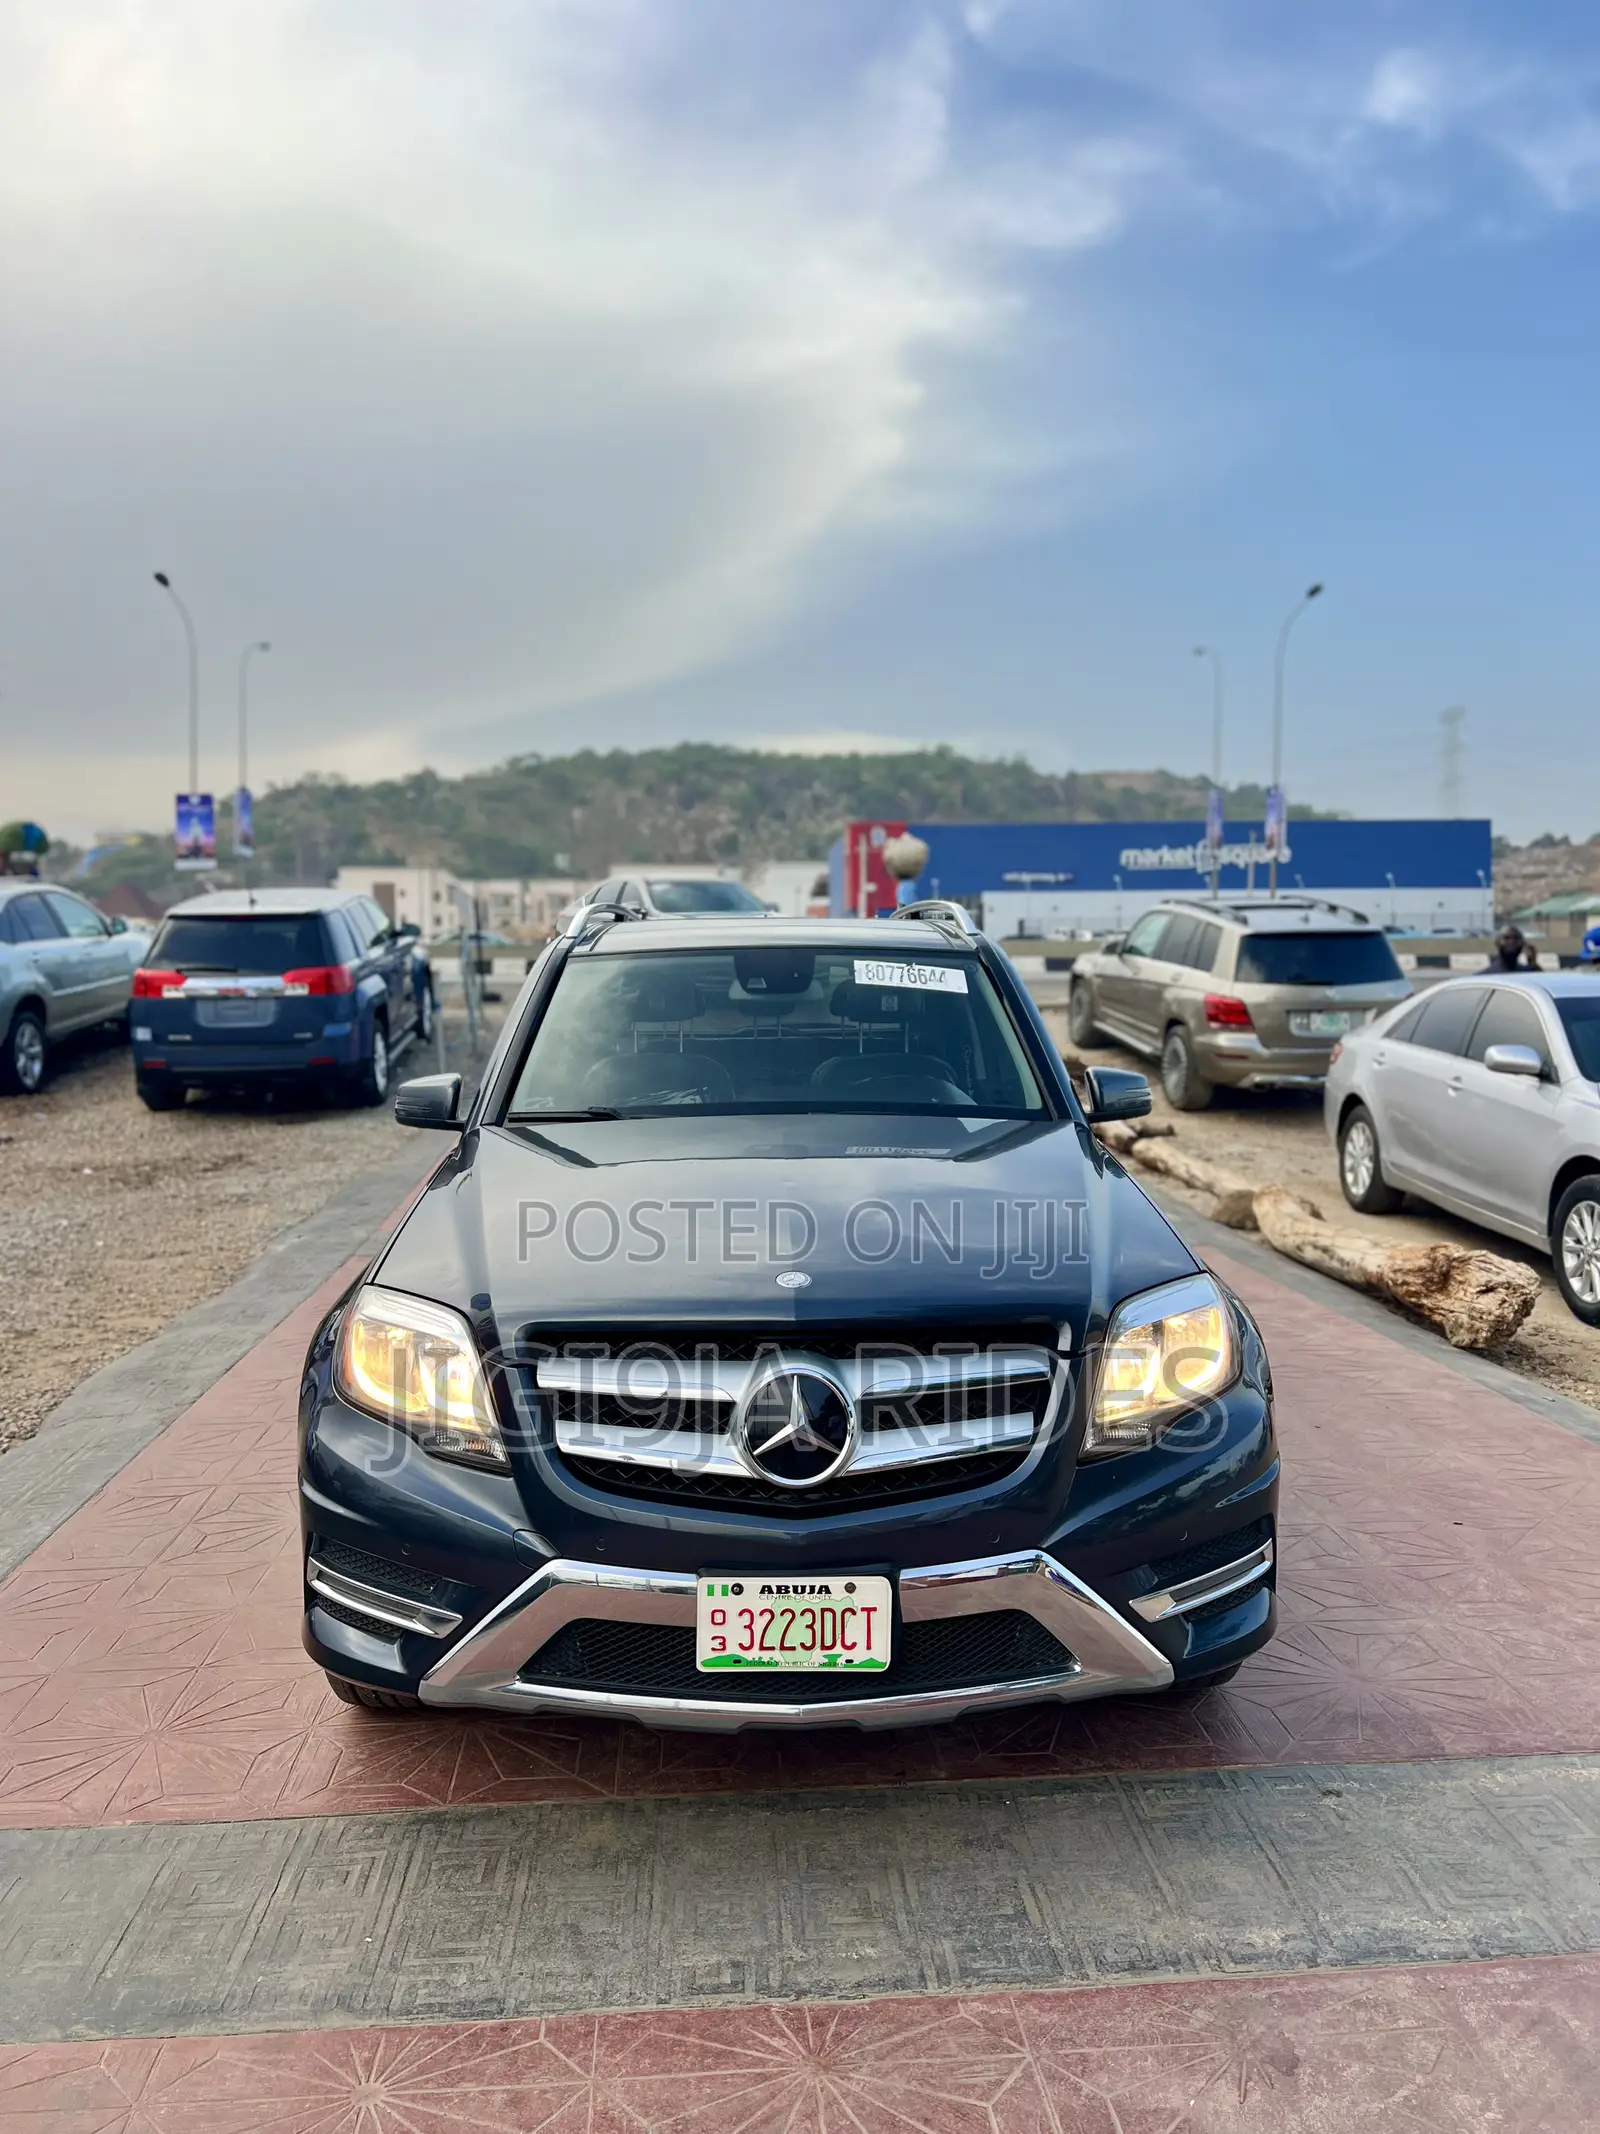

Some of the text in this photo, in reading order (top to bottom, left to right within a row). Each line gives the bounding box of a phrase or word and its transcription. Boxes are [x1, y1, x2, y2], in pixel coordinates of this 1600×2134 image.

[1120, 845, 1197, 870] market
[759, 1585, 832, 1595] ABUJA
[738, 1607, 878, 1651] 3223DCT
